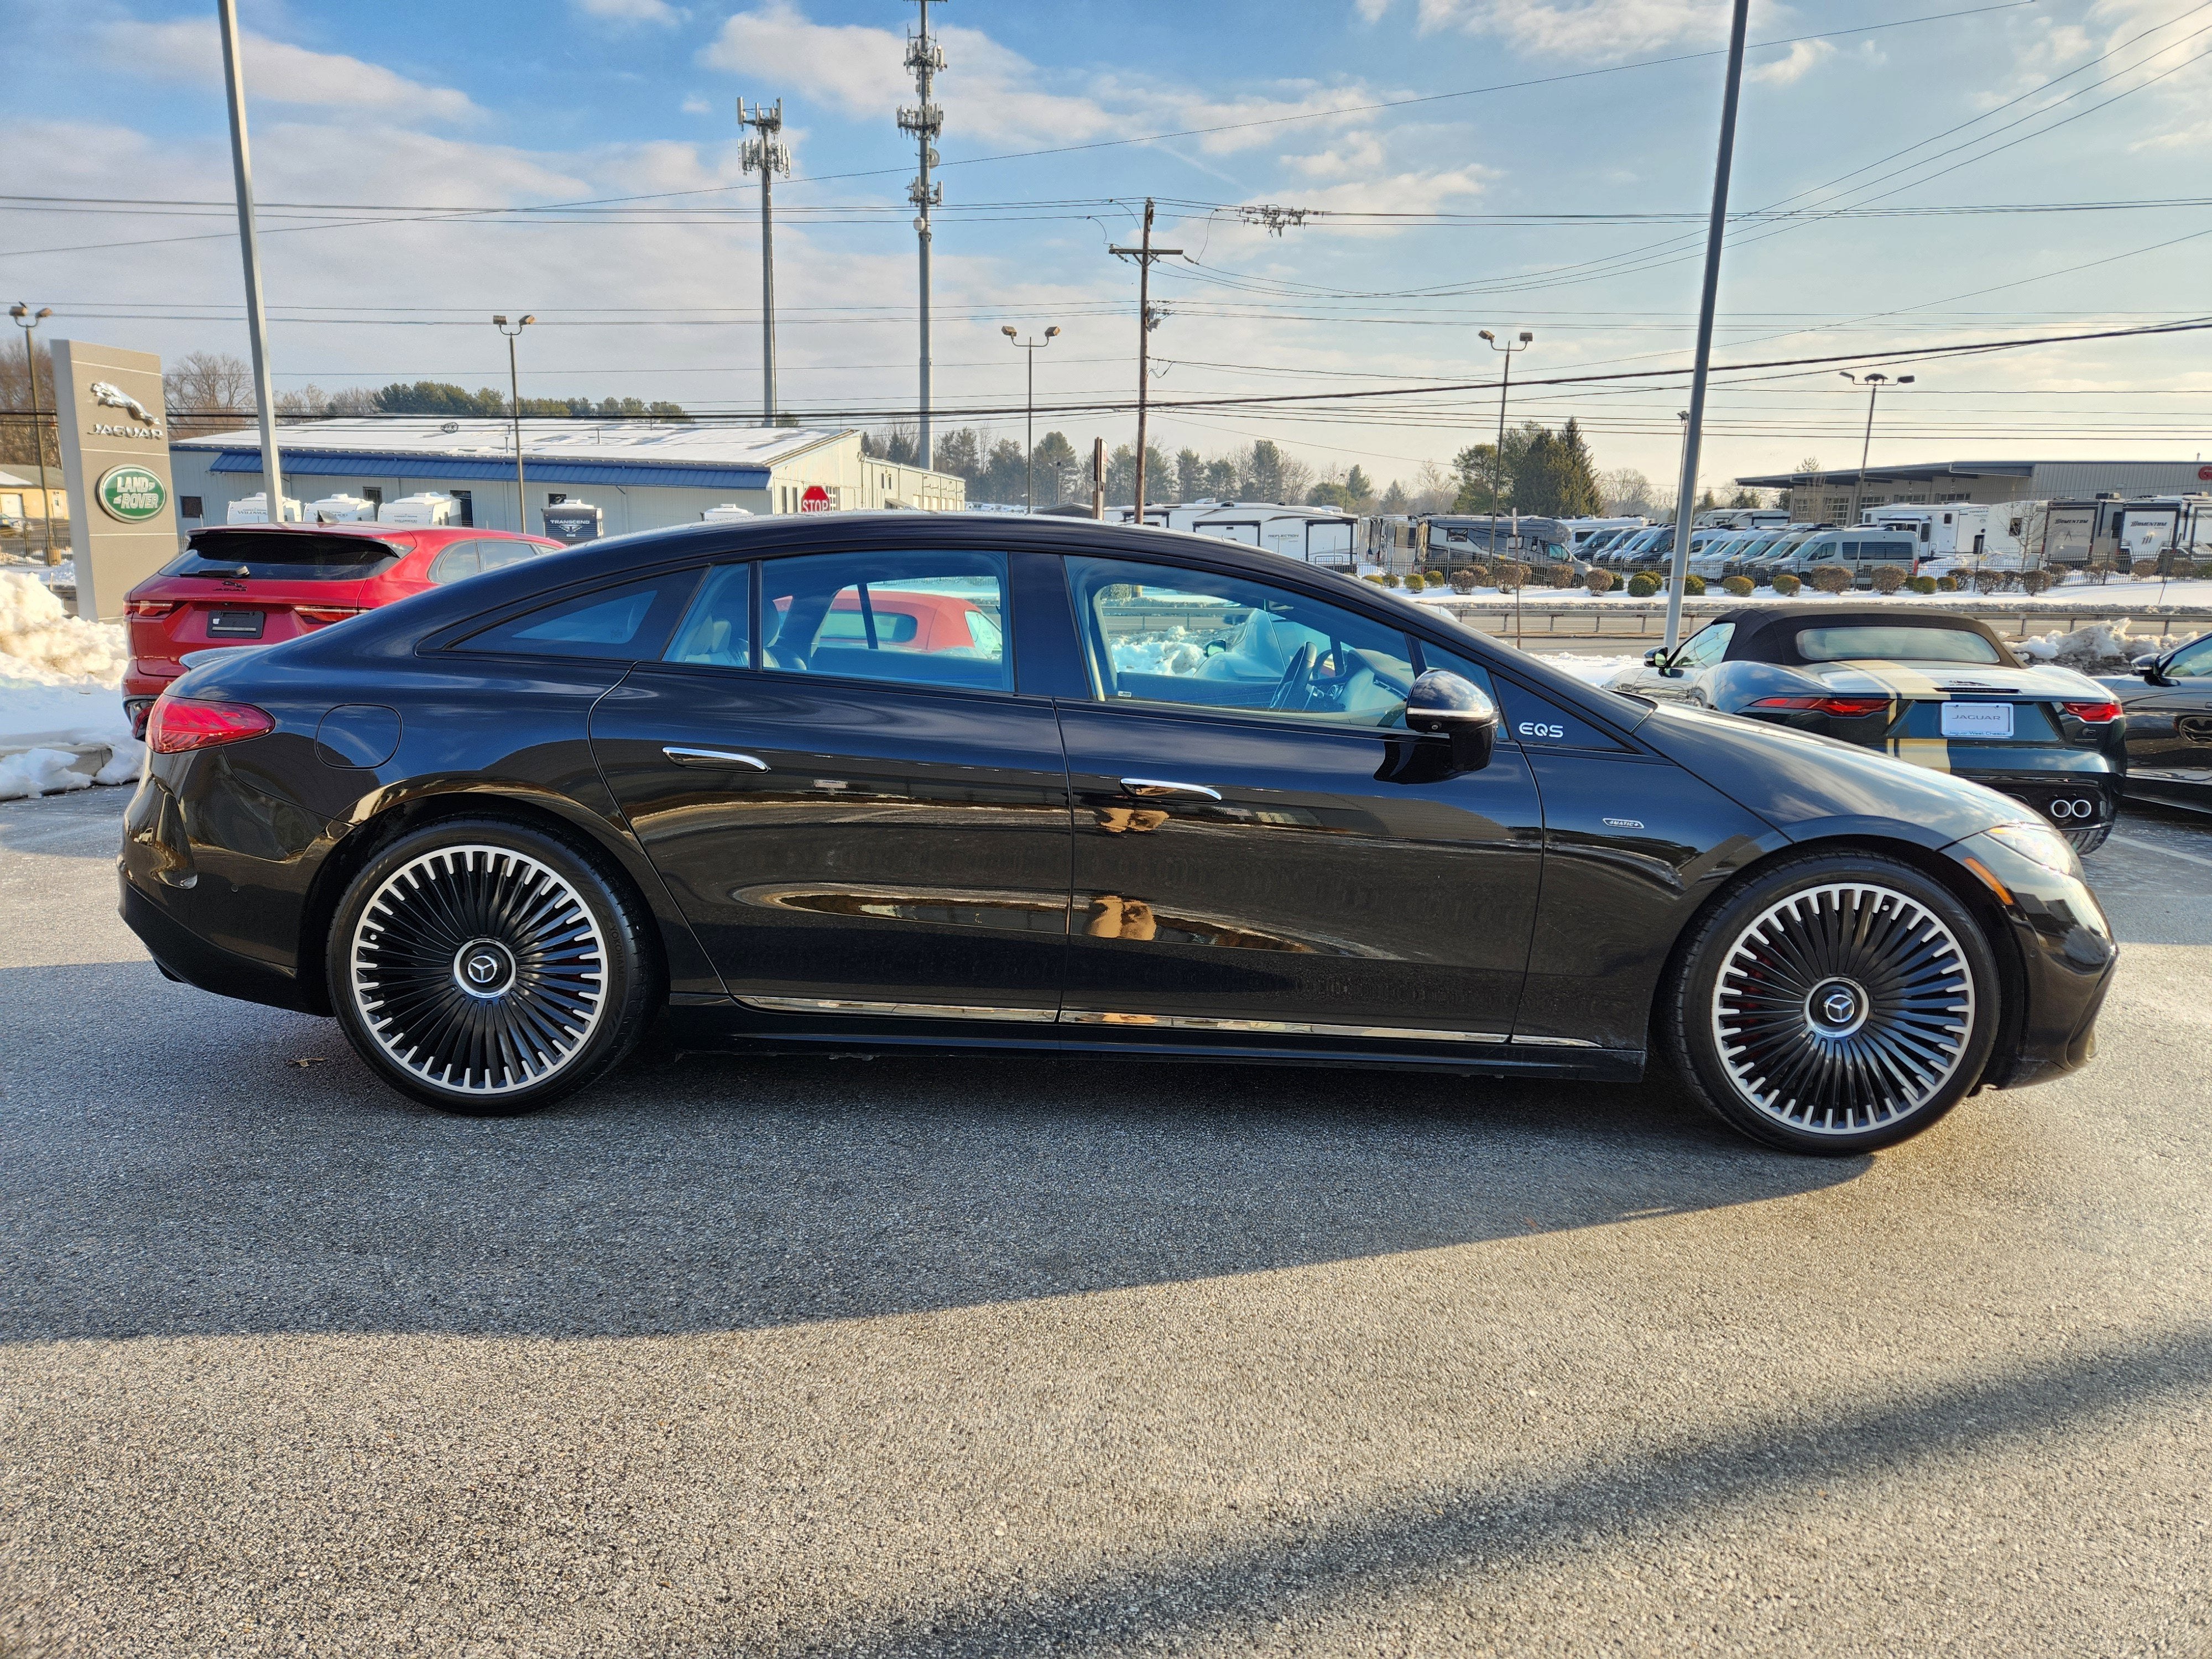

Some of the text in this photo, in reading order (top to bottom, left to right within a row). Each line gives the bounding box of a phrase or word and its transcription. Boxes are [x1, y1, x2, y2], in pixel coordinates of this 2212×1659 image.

[87, 424, 165, 440] JAGUAR
[117, 477, 149, 493] LAND
[121, 493, 159, 509] ROVER
[802, 499, 828, 512] STOP
[1519, 722, 1564, 738] EQS
[609, 925, 624, 981] YOKOHAMA
